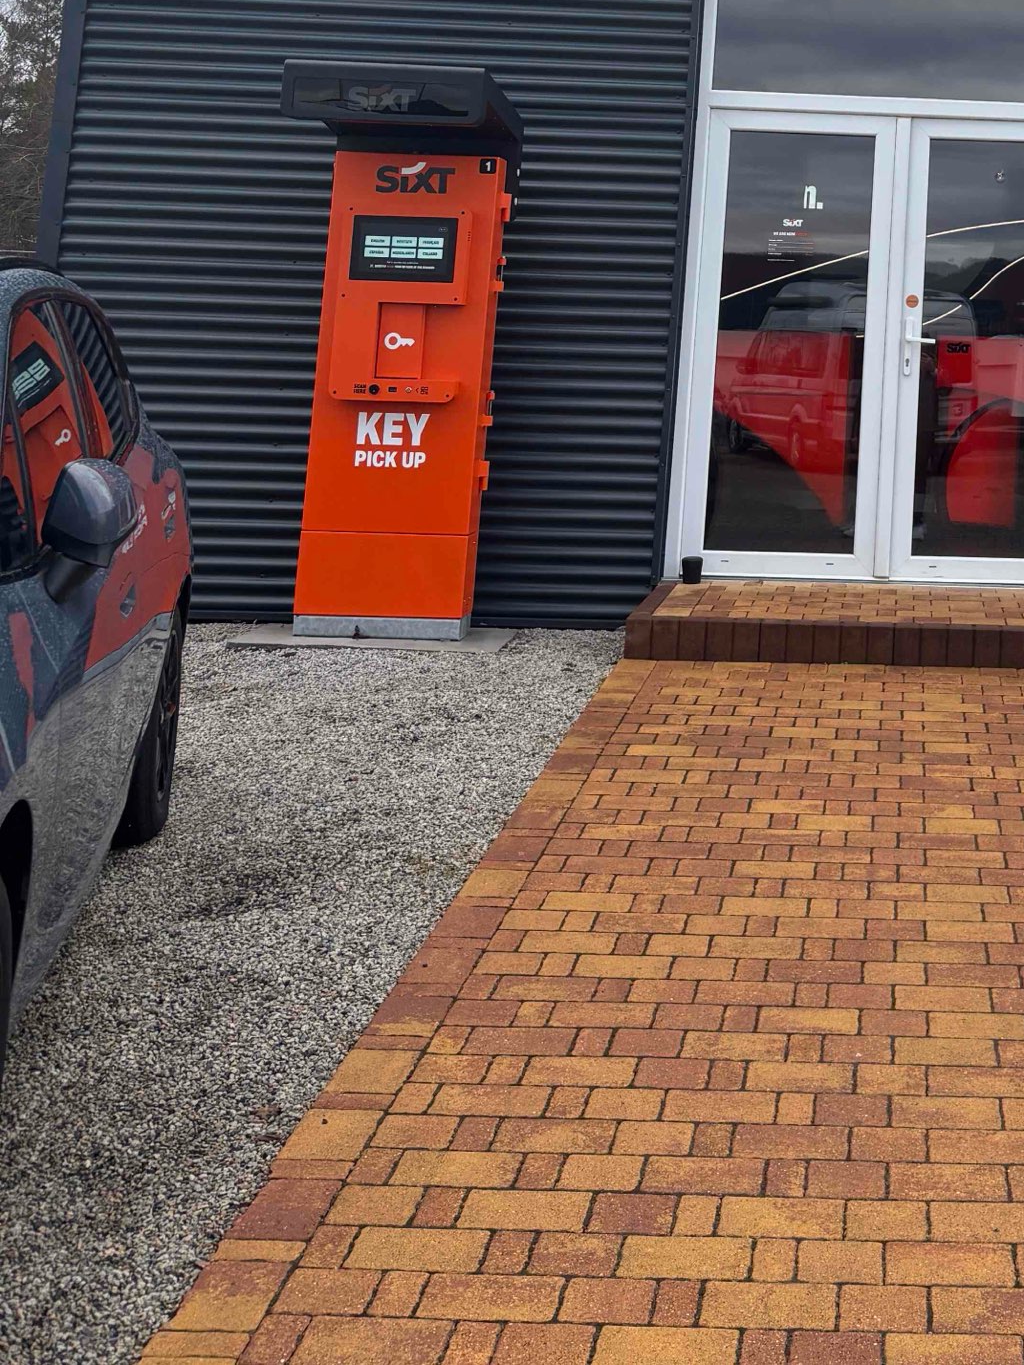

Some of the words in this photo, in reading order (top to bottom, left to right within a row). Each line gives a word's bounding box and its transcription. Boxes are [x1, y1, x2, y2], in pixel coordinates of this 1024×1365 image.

[348, 85, 417, 112] SIXT
[375, 161, 456, 195] SIXT
[485, 161, 491, 172] 1
[356, 411, 431, 447] KEY
[354, 450, 398, 468] PICK
[401, 451, 427, 469] UP
